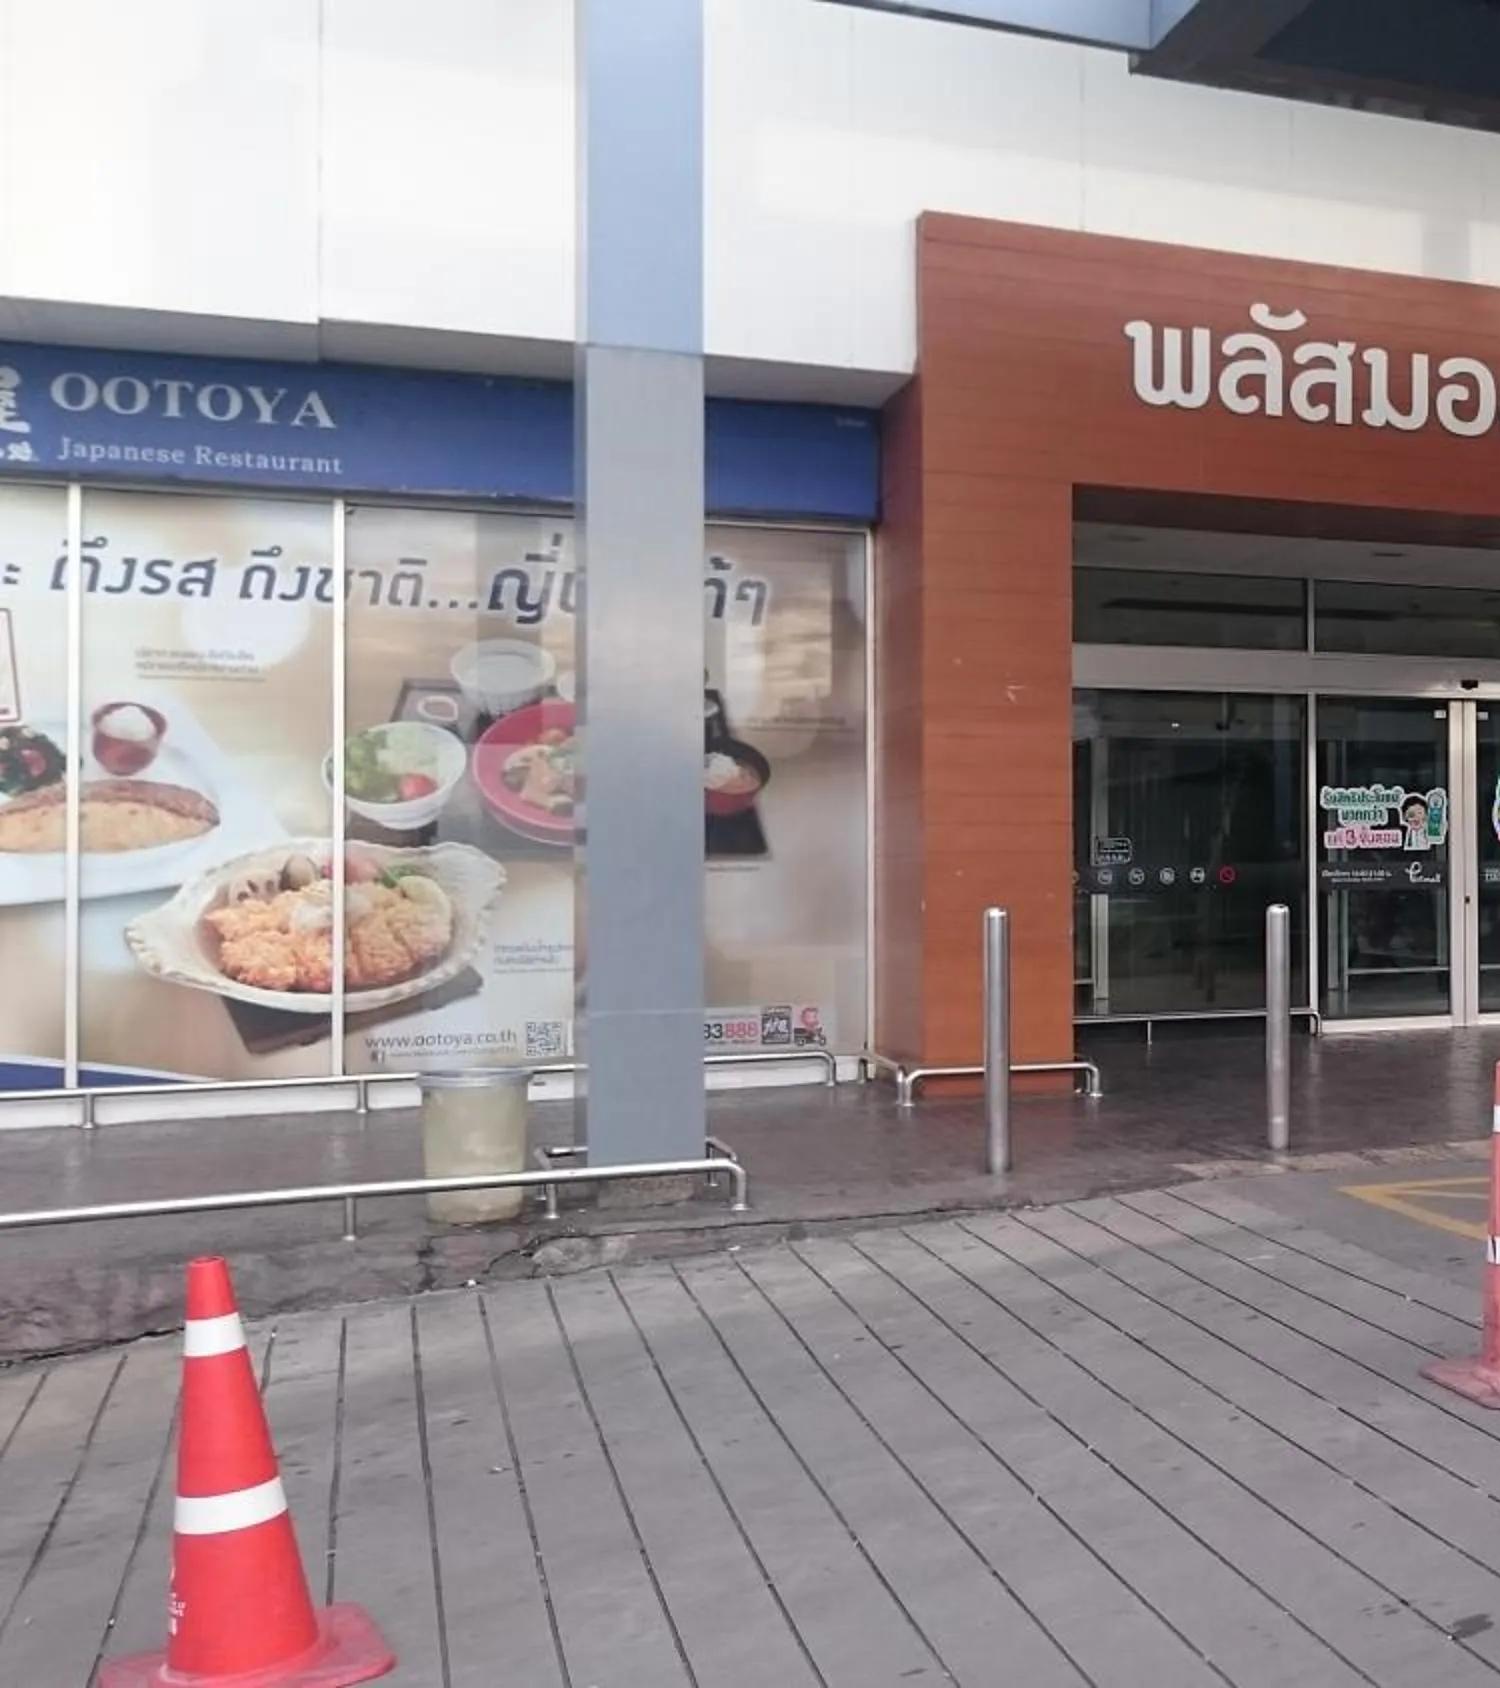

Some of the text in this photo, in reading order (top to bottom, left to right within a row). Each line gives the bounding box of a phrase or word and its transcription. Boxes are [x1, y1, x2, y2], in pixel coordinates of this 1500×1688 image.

[50, 372, 336, 429] OOTOYA
[57, 437, 186, 464] Japanese
[194, 445, 344, 475] Restaurant
[50, 535, 216, 598] ถึงรส
[365, 1030, 518, 1049] www.ootoya.co.th
